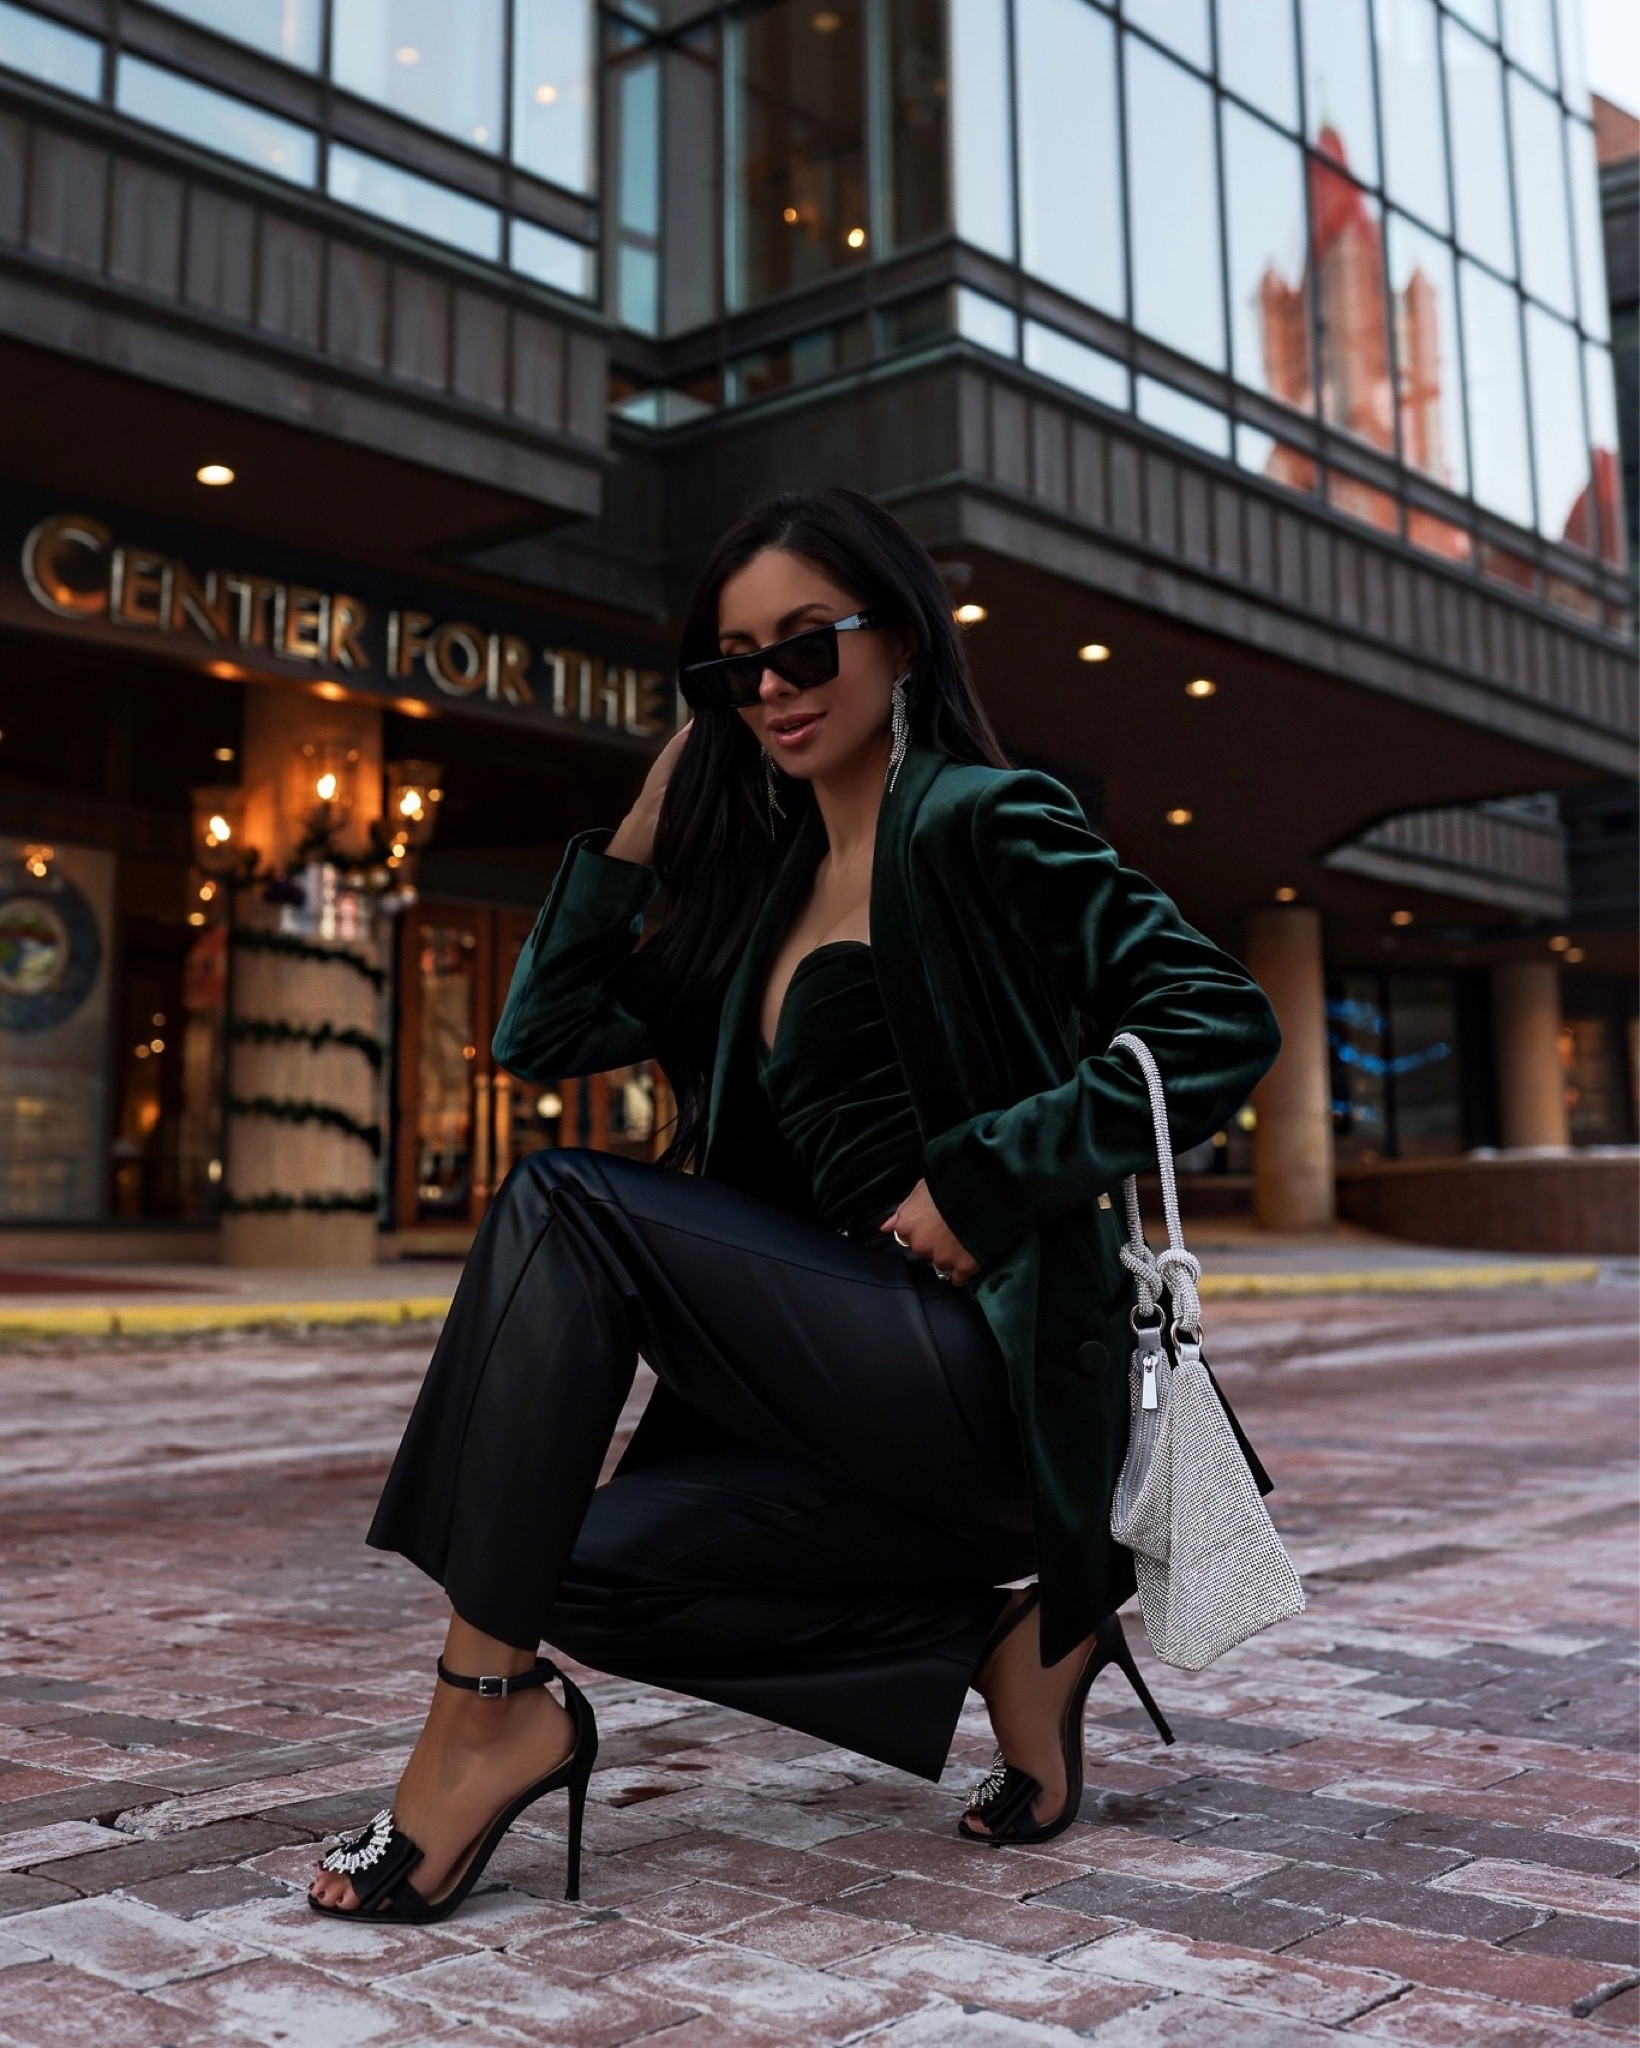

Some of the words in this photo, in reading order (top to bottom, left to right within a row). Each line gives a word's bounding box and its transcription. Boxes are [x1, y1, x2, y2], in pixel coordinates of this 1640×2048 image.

[20, 513, 369, 670] CENTER
[386, 611, 533, 706] FOR
[543, 647, 666, 738] THE
